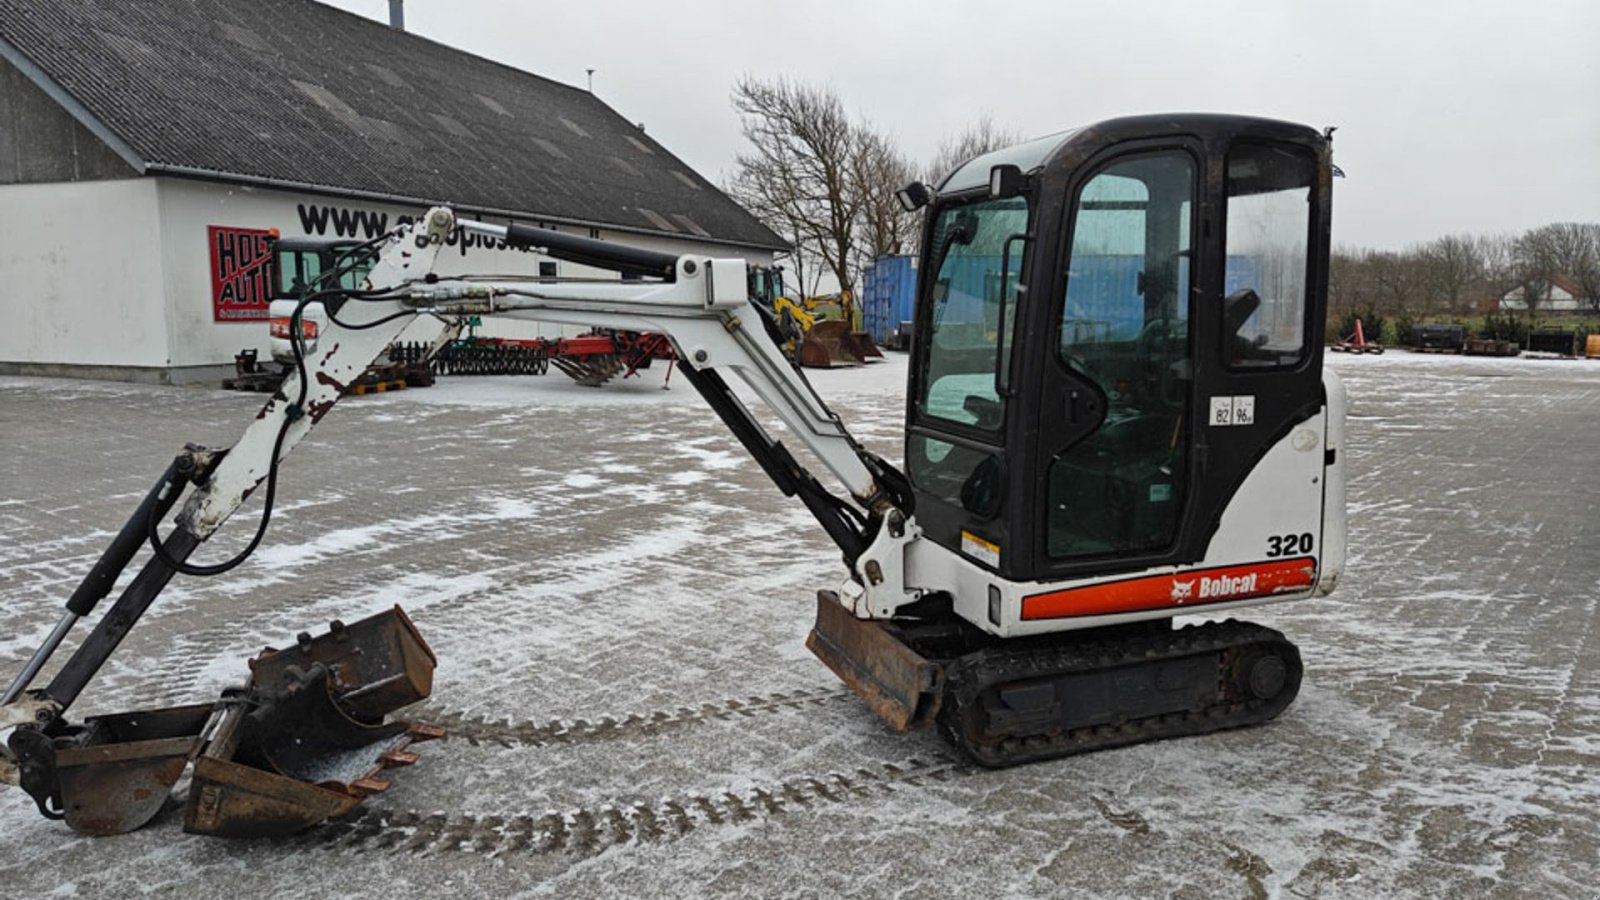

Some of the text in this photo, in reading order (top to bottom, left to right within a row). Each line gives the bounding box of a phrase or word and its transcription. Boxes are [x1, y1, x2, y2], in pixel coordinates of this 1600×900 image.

[1216, 408, 1229, 423] 82
[1266, 533, 1313, 557] 320
[1199, 574, 1257, 598] Bobcat
